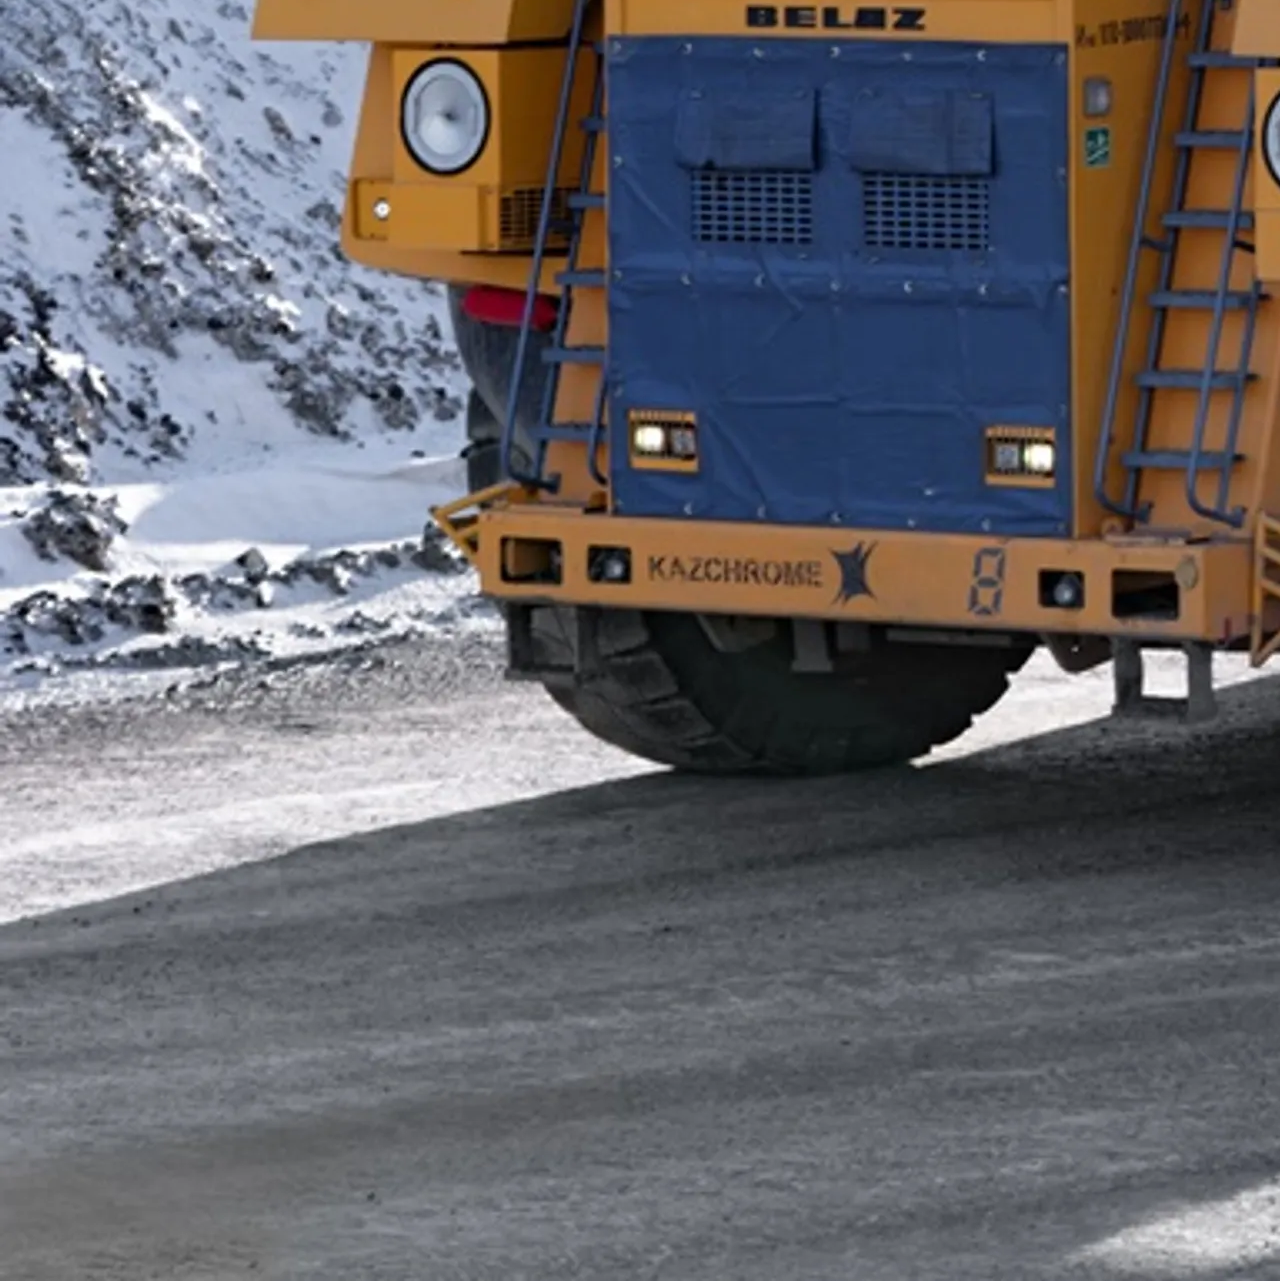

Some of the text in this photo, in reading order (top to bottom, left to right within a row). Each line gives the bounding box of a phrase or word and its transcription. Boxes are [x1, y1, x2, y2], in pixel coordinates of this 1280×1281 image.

[746, 5, 926, 30] BELAZ
[648, 555, 824, 588] KAZCHROME
[967, 547, 1005, 616] 8
